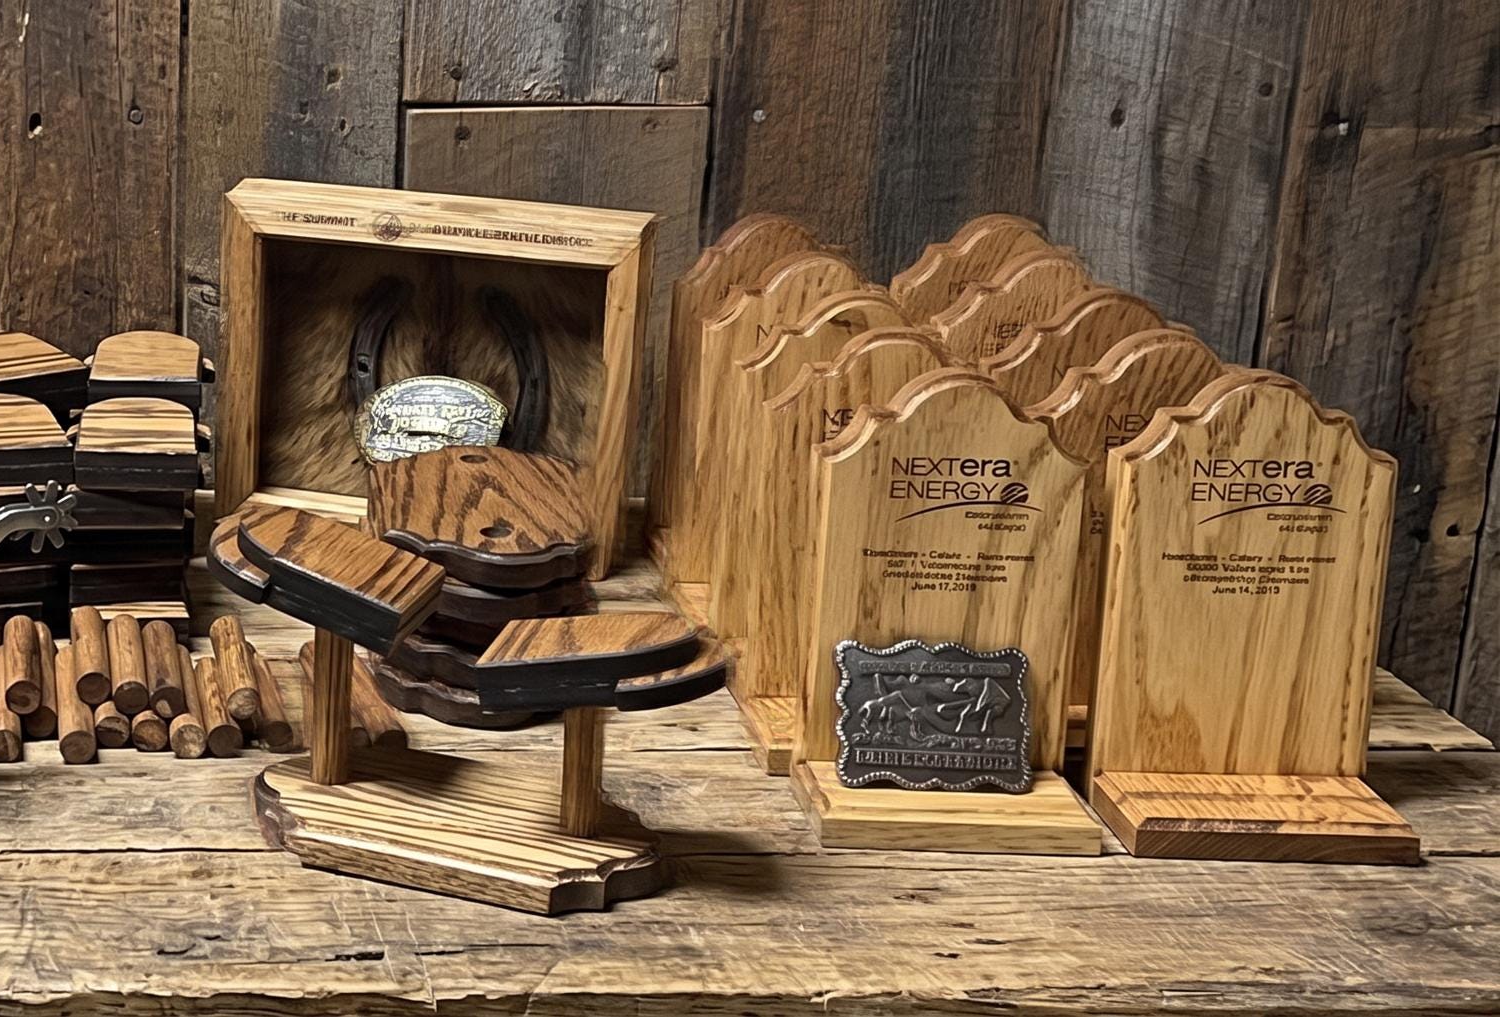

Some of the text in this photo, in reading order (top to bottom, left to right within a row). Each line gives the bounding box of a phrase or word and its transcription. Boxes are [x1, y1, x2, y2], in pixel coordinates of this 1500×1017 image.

[891, 457, 1012, 477] NEXTera
[1193, 459, 1315, 479] NEXTera
[889, 480, 999, 501] ENERGY
[1191, 482, 1301, 503] ENERGY
[1212, 585, 1236, 594] June
